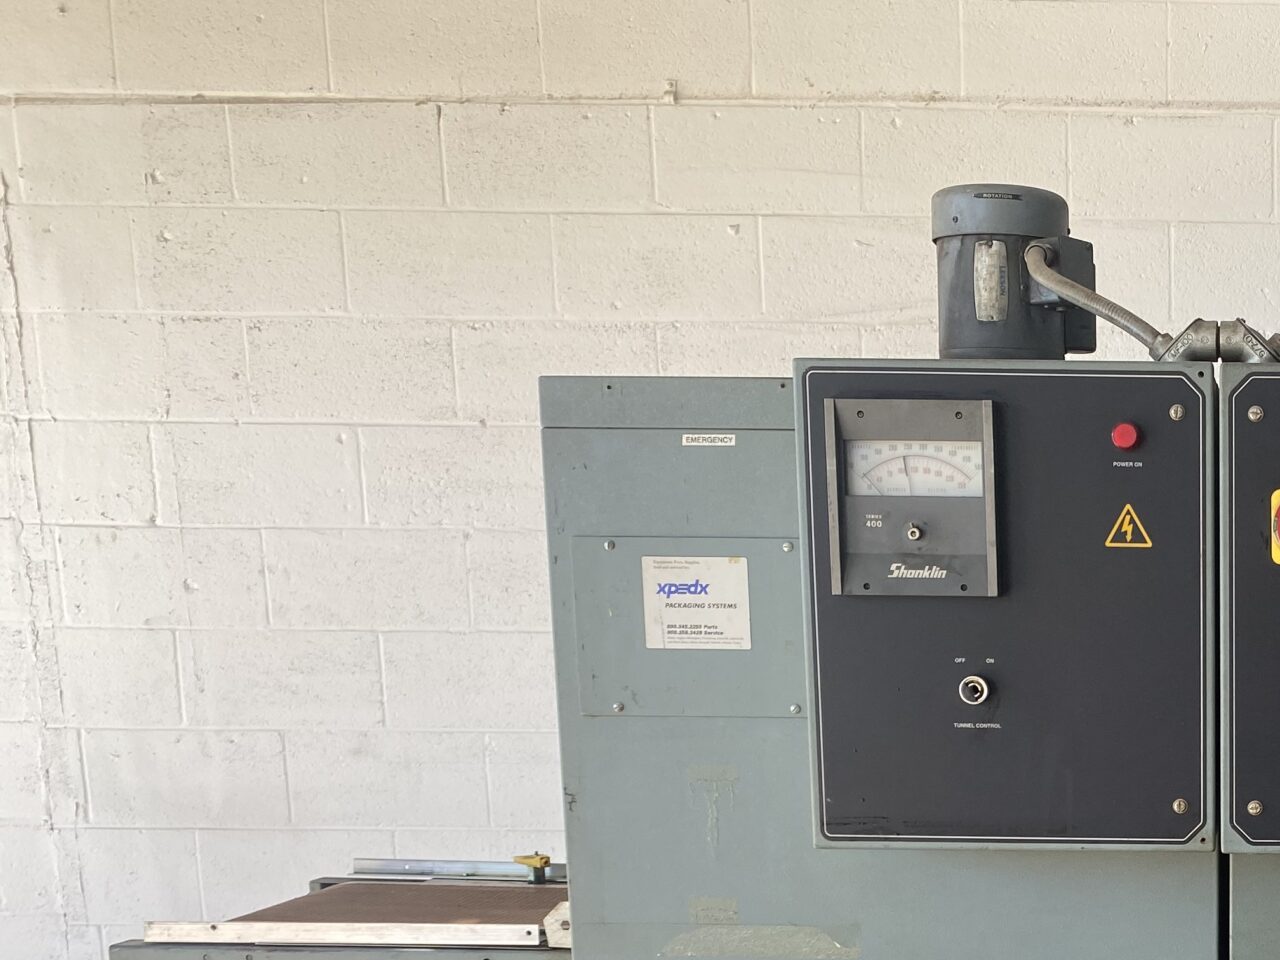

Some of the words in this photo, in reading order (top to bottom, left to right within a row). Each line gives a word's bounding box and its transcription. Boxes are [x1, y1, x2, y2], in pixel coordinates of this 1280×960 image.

[685, 436, 733, 444] EMERGENCY
[888, 563, 947, 579] Shanklin
[656, 579, 710, 599] xpedx
